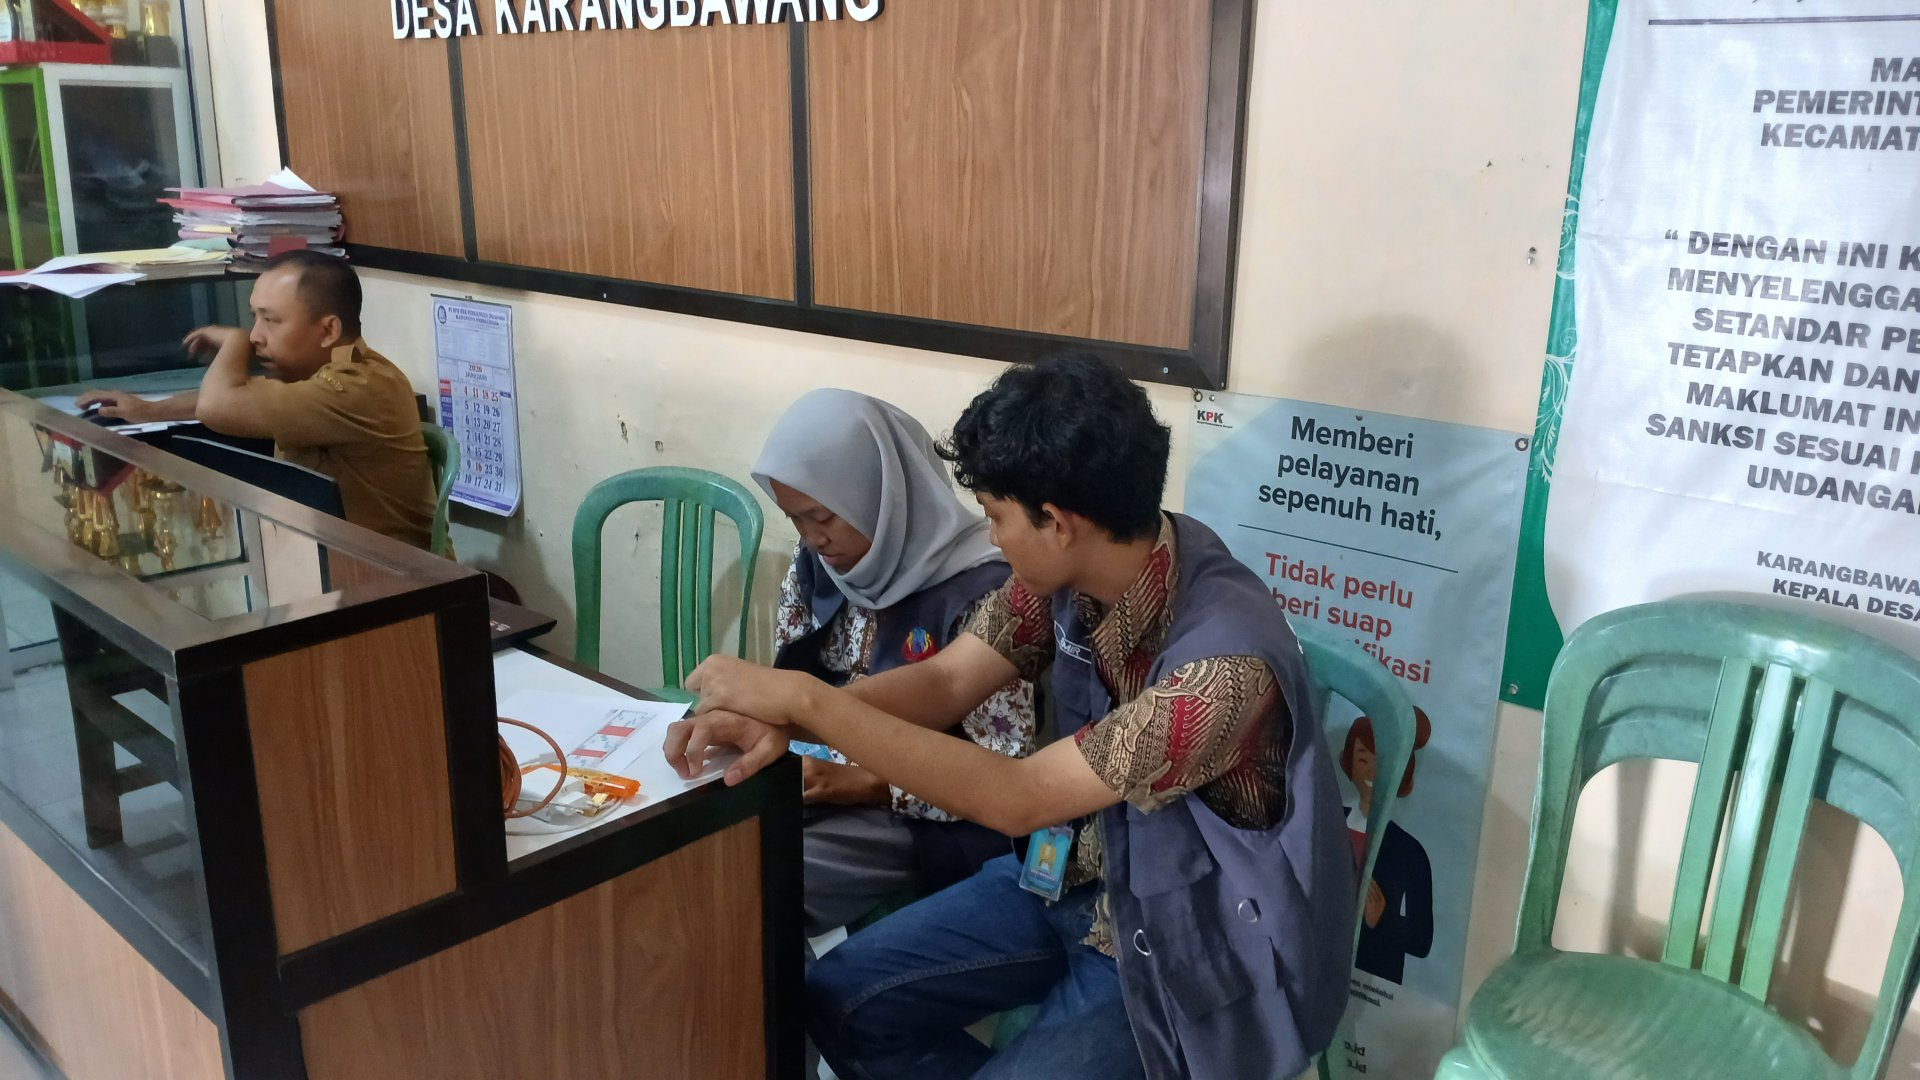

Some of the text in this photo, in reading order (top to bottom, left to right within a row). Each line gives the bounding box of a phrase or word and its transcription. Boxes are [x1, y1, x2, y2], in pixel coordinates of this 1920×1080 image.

[389, 0, 477, 39] DESA
[1761, 123, 1920, 151] KECAMAT
[1687, 230, 1828, 264] DENGAN
[1837, 241, 1888, 269] INI
[1667, 267, 1920, 313] MENYELENGGA
[1692, 308, 1871, 349] SETANDAR
[1668, 342, 1920, 394] TETAPKAN DAN
[1197, 410, 1224, 424] KPK
[1686, 382, 1875, 427] MAKLUMAT
[1291, 415, 1414, 458] Memberi
[1646, 413, 1766, 451] SANKSI
[1773, 432, 1901, 471] SESUAI
[1278, 454, 1420, 496] pelayanan
[1747, 465, 1920, 515] UNDANGA
[1258, 484, 1442, 540] sepenuh hati,
[1265, 552, 1413, 609] Tidak perlu
[1757, 551, 1920, 597] KARANGBAWA
[1772, 579, 1860, 609] KEPALA
[1272, 588, 1392, 641] beri suap
